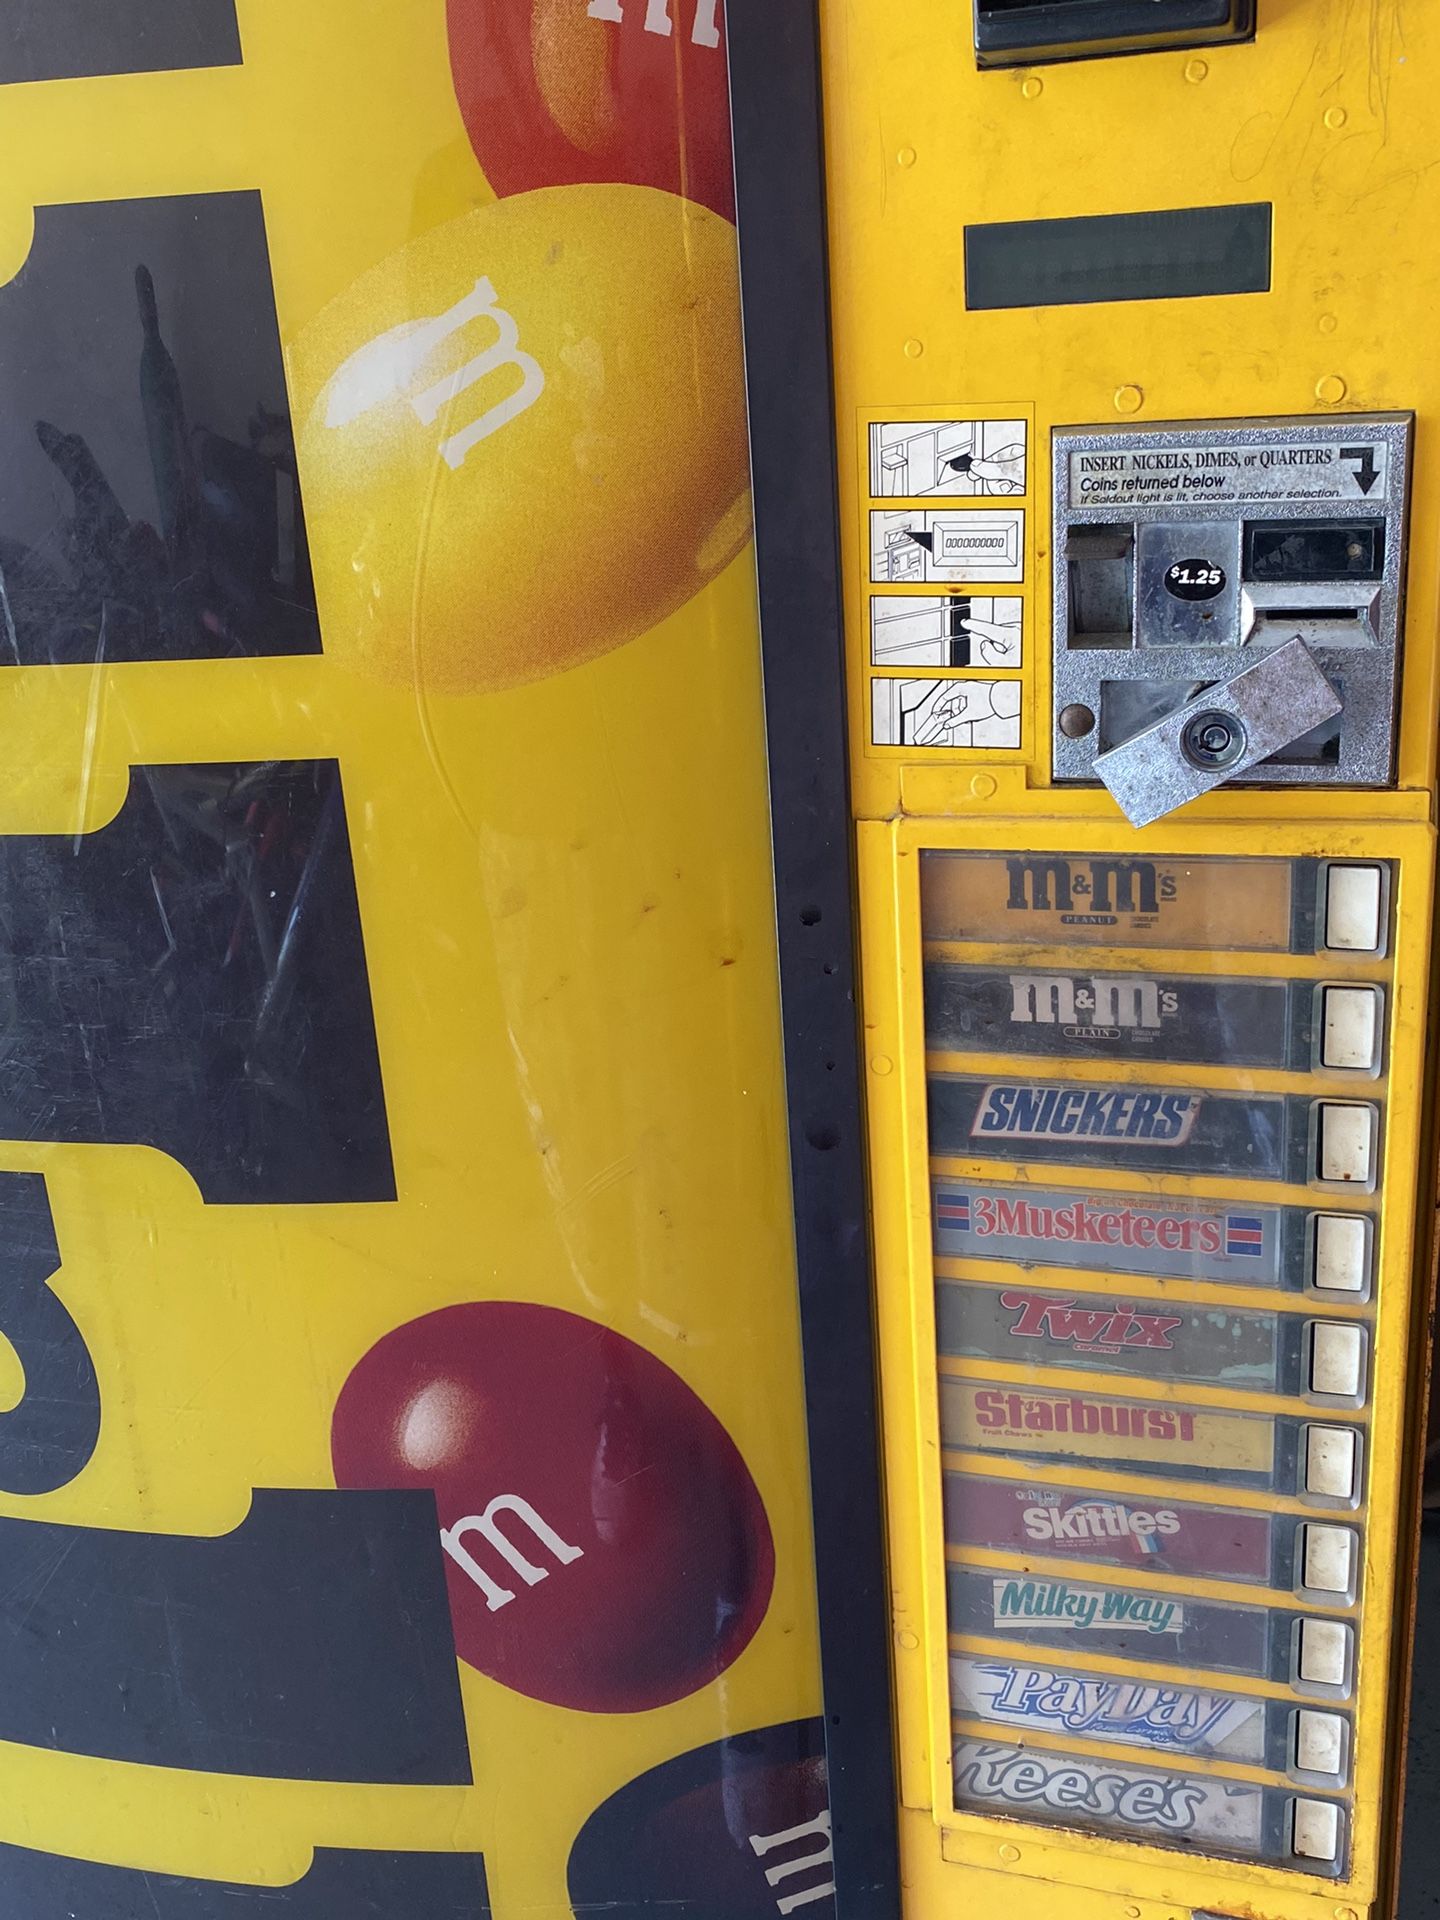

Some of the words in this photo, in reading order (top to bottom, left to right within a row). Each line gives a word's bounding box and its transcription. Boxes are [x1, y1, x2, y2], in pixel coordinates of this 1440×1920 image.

[1080, 456, 1126, 472] INSERT
[1132, 453, 1192, 470] NICKELS,
[1195, 451, 1241, 468] DIMES,
[1244, 454, 1256, 466] or
[1260, 448, 1332, 468] QUARTERS
[1080, 477, 1118, 492] Coins
[1121, 475, 1179, 490] returned
[1182, 473, 1226, 488] below
[1080, 496, 1087, 504] If
[1090, 494, 1134, 504] Soldout
[1136, 493, 1161, 504] light
[1163, 492, 1174, 501] is
[1192, 490, 1235, 501] choose
[1238, 489, 1283, 500] another
[1286, 488, 1342, 499] selection.
[1170, 565, 1221, 585] $1.25
[1064, 915, 1115, 925] PEANUT
[981, 1087, 1191, 1140] SNICKERS
[1000, 1291, 1182, 1350] Twix
[975, 1391, 1195, 1441] Starburst
[1022, 1505, 1181, 1540] Skittles
[999, 1581, 1099, 1628] Milky
[1102, 1591, 1176, 1633] Way
[995, 1666, 1230, 1740] PayDay
